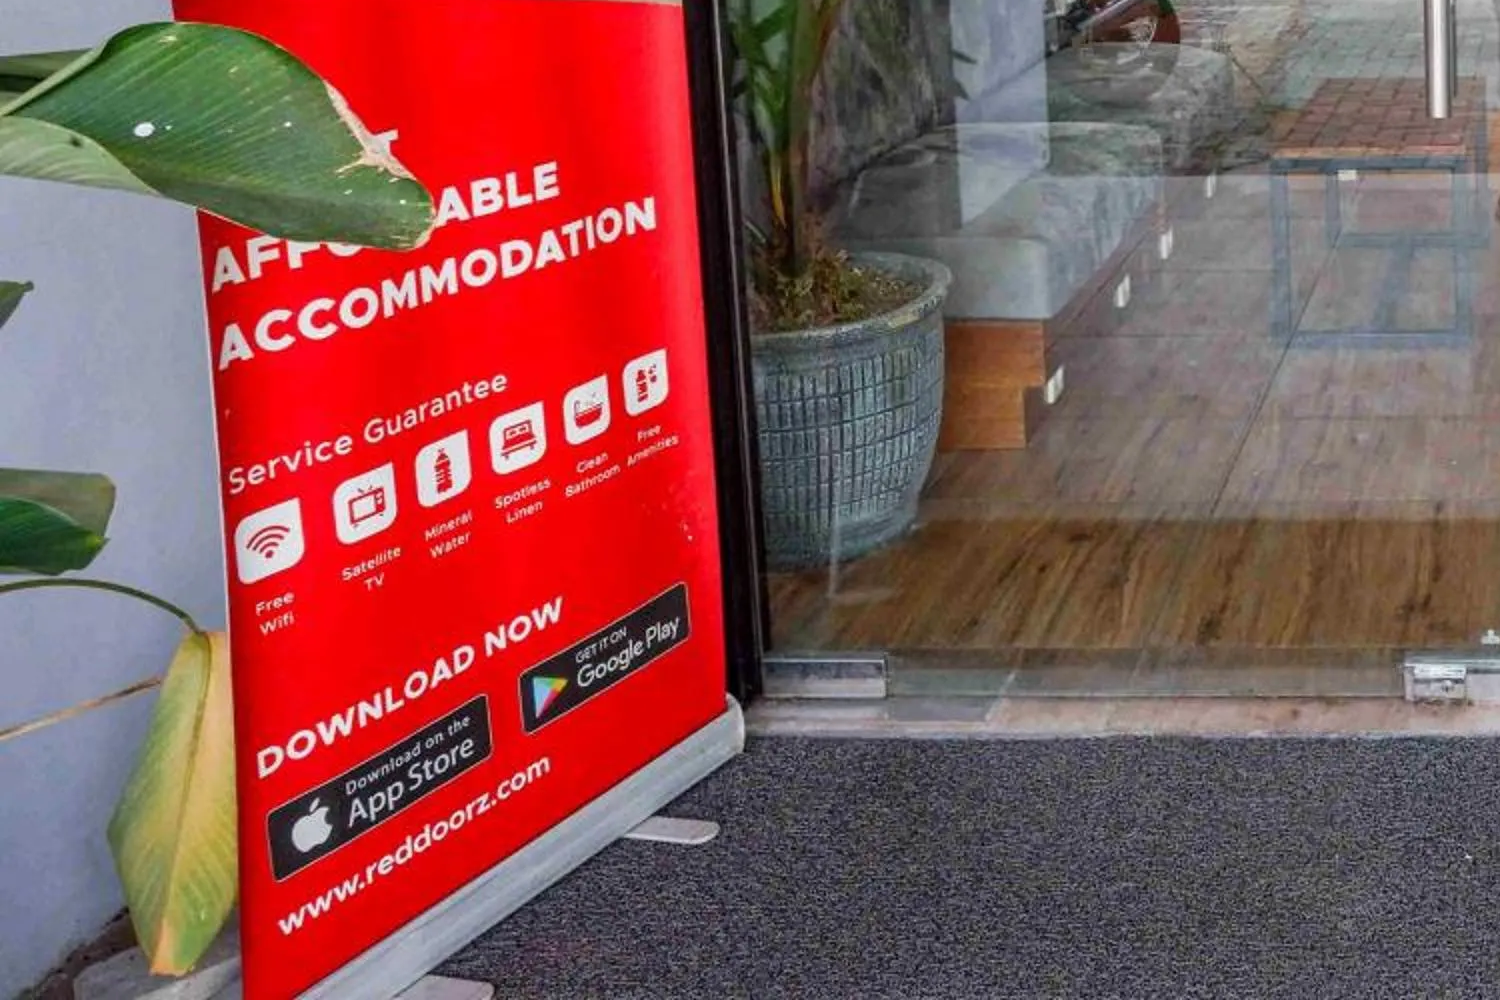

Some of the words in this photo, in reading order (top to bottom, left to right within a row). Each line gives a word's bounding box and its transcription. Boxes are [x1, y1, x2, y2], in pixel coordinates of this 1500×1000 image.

[211, 161, 560, 293] AFFABLE
[218, 197, 657, 371] ACCOMMODATION
[229, 434, 353, 495] Service
[364, 373, 508, 444] Guarantee
[637, 424, 663, 444] Free
[576, 451, 608, 474] Clean
[627, 435, 680, 468] Amenities
[495, 477, 551, 511] Spotless
[564, 464, 620, 498] Bathroom
[424, 510, 473, 542] Mineral
[506, 500, 544, 524] Linen
[429, 532, 471, 560] Water
[341, 546, 401, 582] Satellite
[363, 573, 385, 592] TV
[255, 592, 295, 617] Free
[260, 611, 295, 637] Wifi
[576, 643, 597, 663] GET
[609, 626, 627, 644] ON
[577, 639, 643, 687] Google
[646, 616, 680, 649] Play
[256, 645, 474, 779] DOWNLOAD
[484, 596, 564, 659] NOW
[345, 740, 421, 796] Download
[426, 732, 446, 750] on
[447, 714, 471, 738] the
[347, 780, 404, 828] App
[408, 736, 474, 790] Store
[278, 753, 551, 936] www.reddoorz.com
